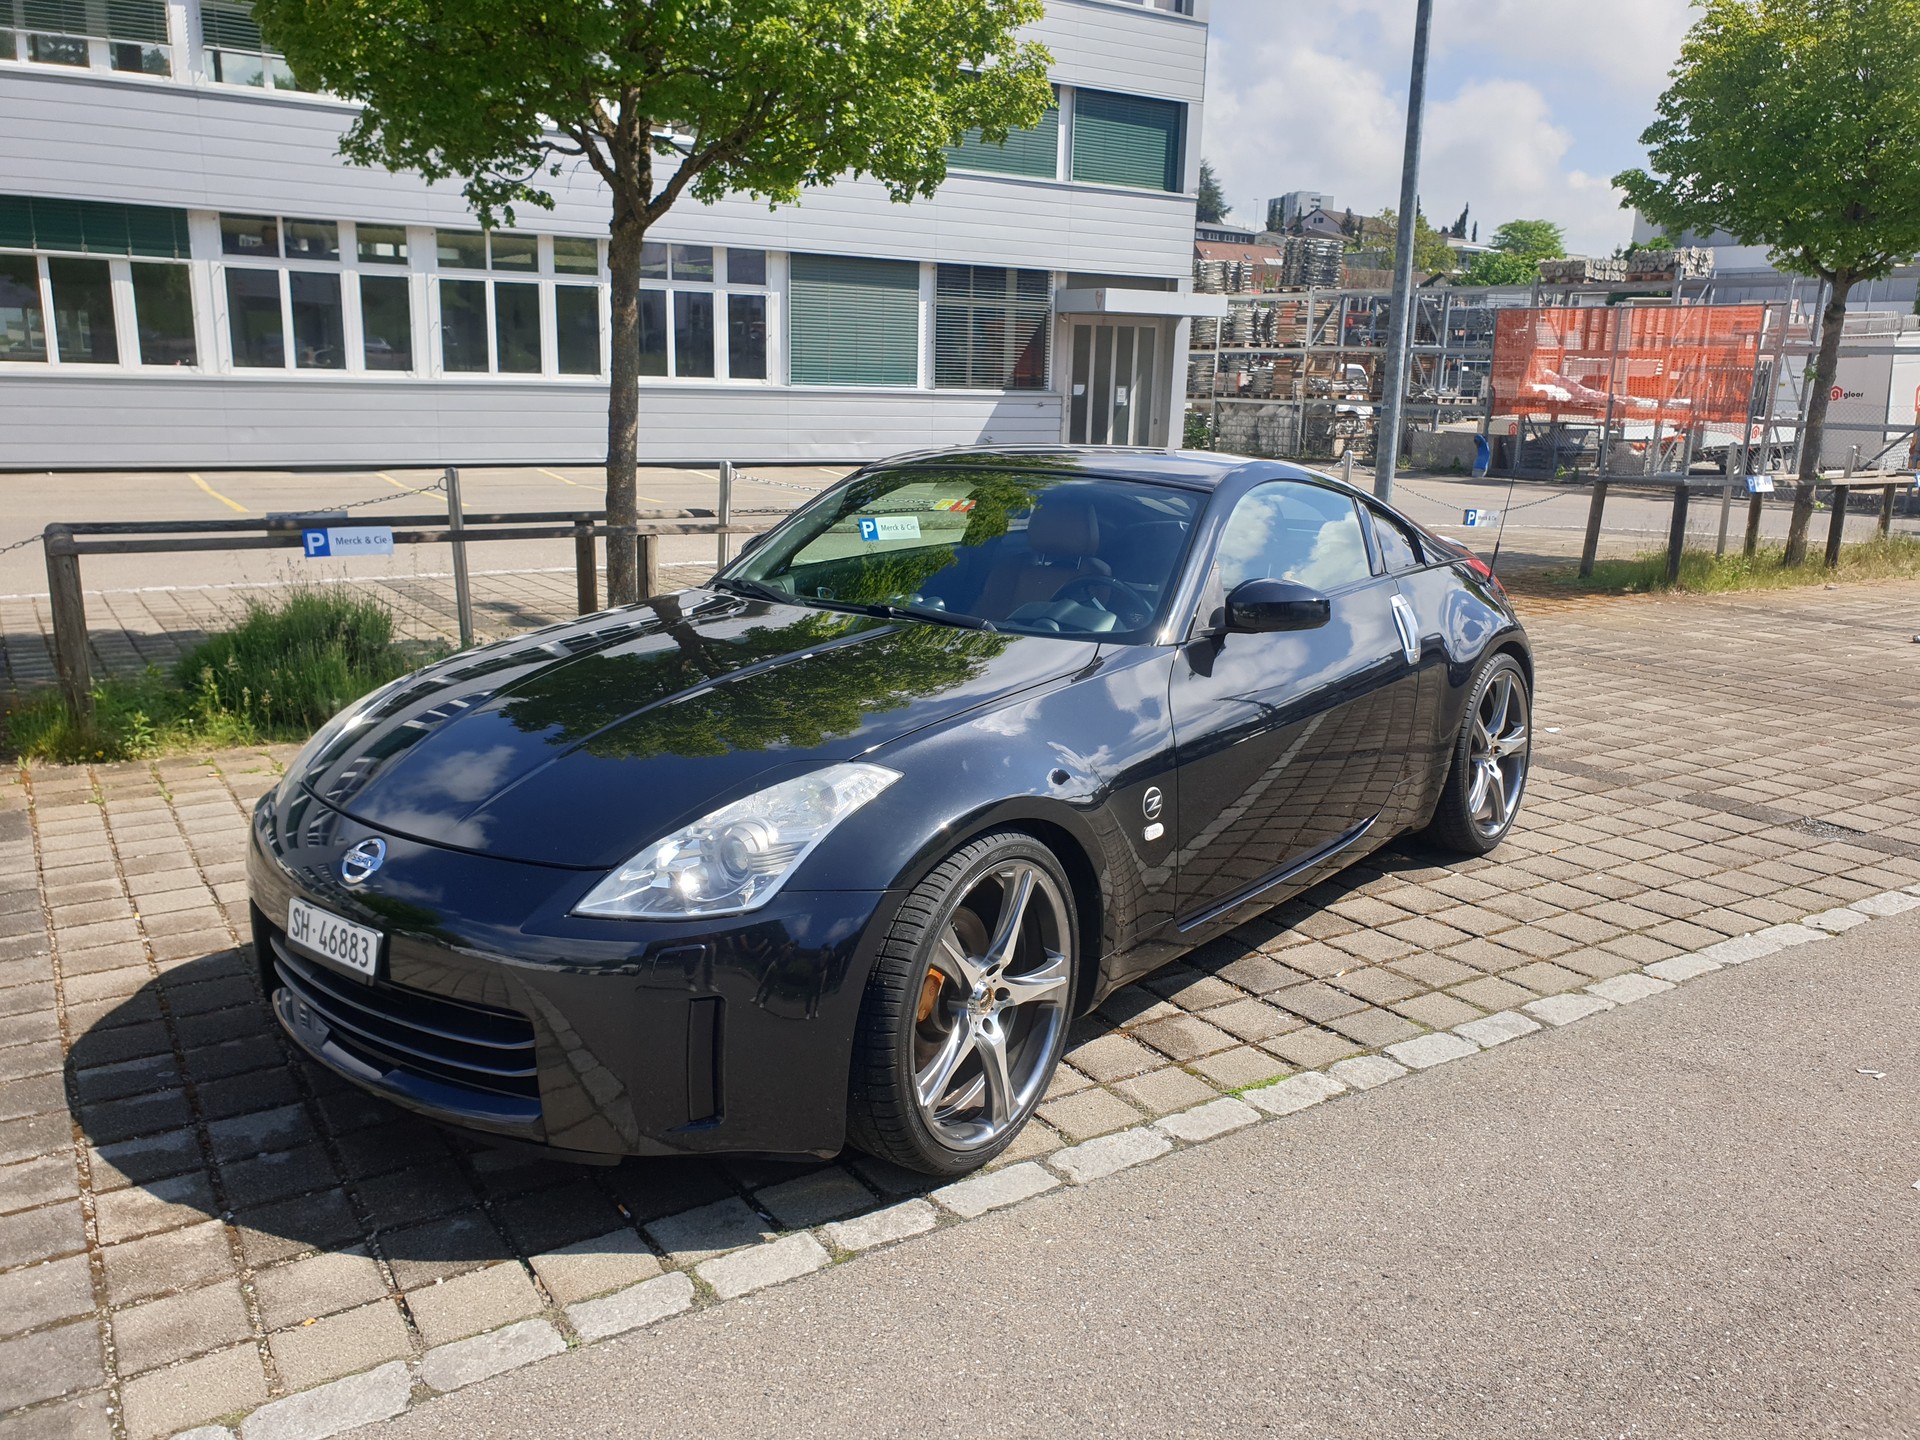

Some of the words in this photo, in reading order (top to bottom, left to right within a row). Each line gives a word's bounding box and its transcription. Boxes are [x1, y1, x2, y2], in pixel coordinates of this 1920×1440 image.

[1844, 391, 1864, 399] gloor
[1467, 511, 1476, 525] P
[861, 521, 874, 538] P
[881, 523, 898, 531] Merck
[307, 533, 325, 554] P
[335, 537, 361, 545] Merck
[374, 535, 388, 544] Cie
